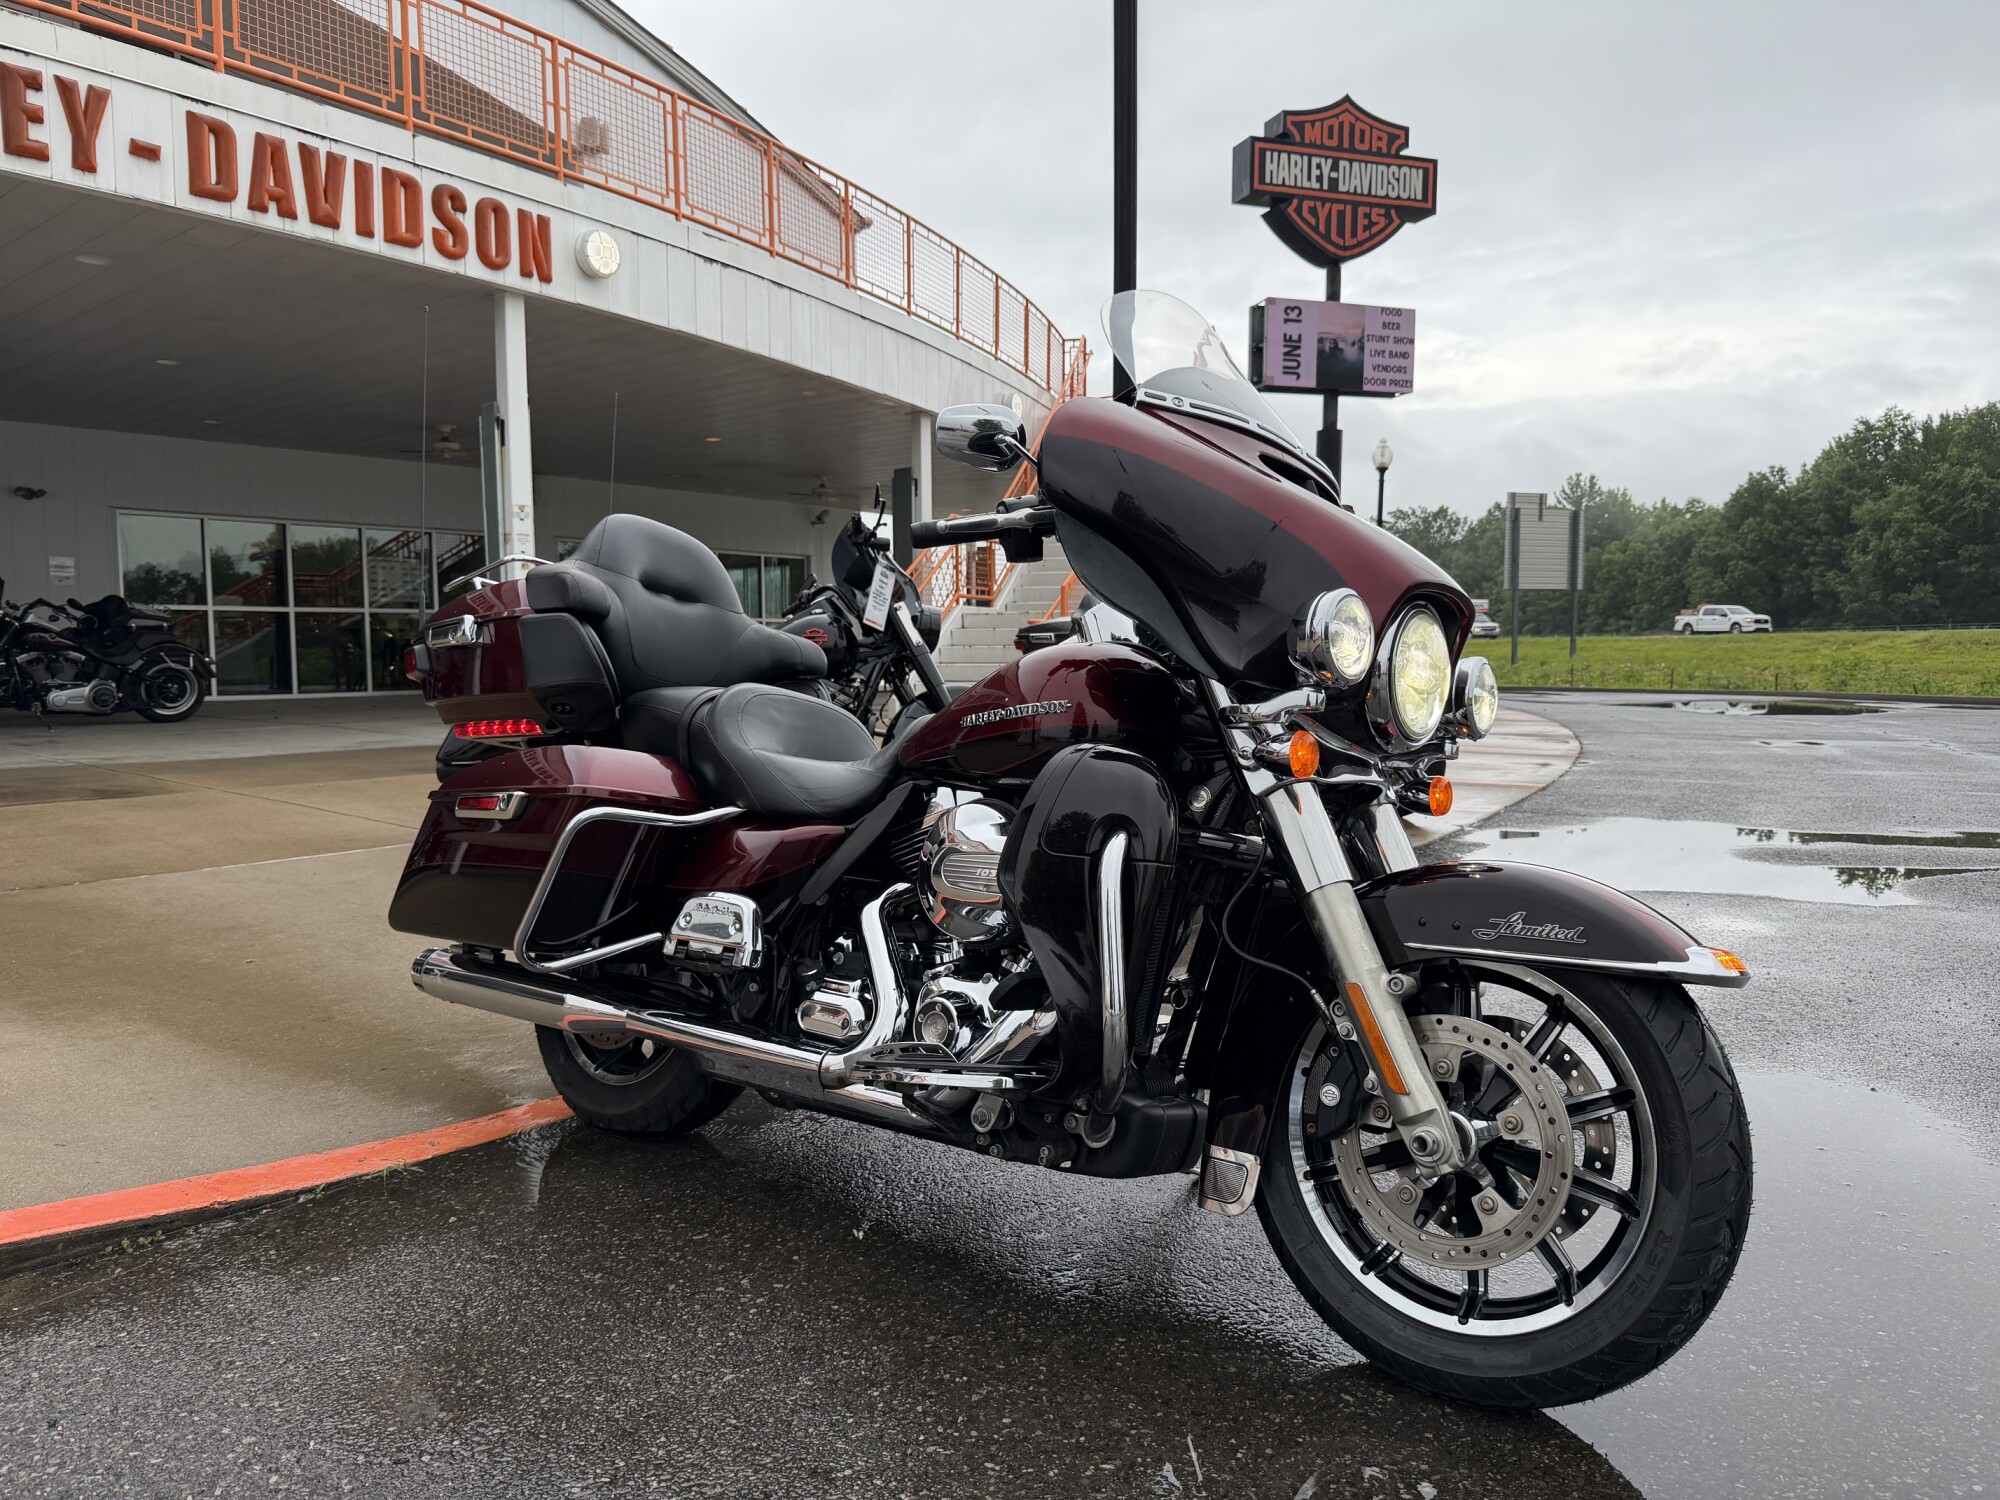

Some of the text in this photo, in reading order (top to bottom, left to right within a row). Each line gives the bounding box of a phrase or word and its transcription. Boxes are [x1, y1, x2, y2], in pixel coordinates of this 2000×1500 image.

[1304, 112, 1388, 153] MOTOR
[1265, 151, 1423, 200] HARLEY-DAVIDSON
[1302, 201, 1387, 246] CYCLES
[1380, 307, 1402, 317] FOOD
[1382, 321, 1400, 331] BEER
[1282, 305, 1303, 380] JUNE 13
[1366, 334, 1414, 345] STUNT SHOW
[1370, 349, 1409, 360] LIVE BAND
[1372, 363, 1407, 374] VENDORS
[1363, 377, 1386, 386] DOOR
[975, 868, 998, 877] 103
[1472, 911, 1587, 943] Limited
